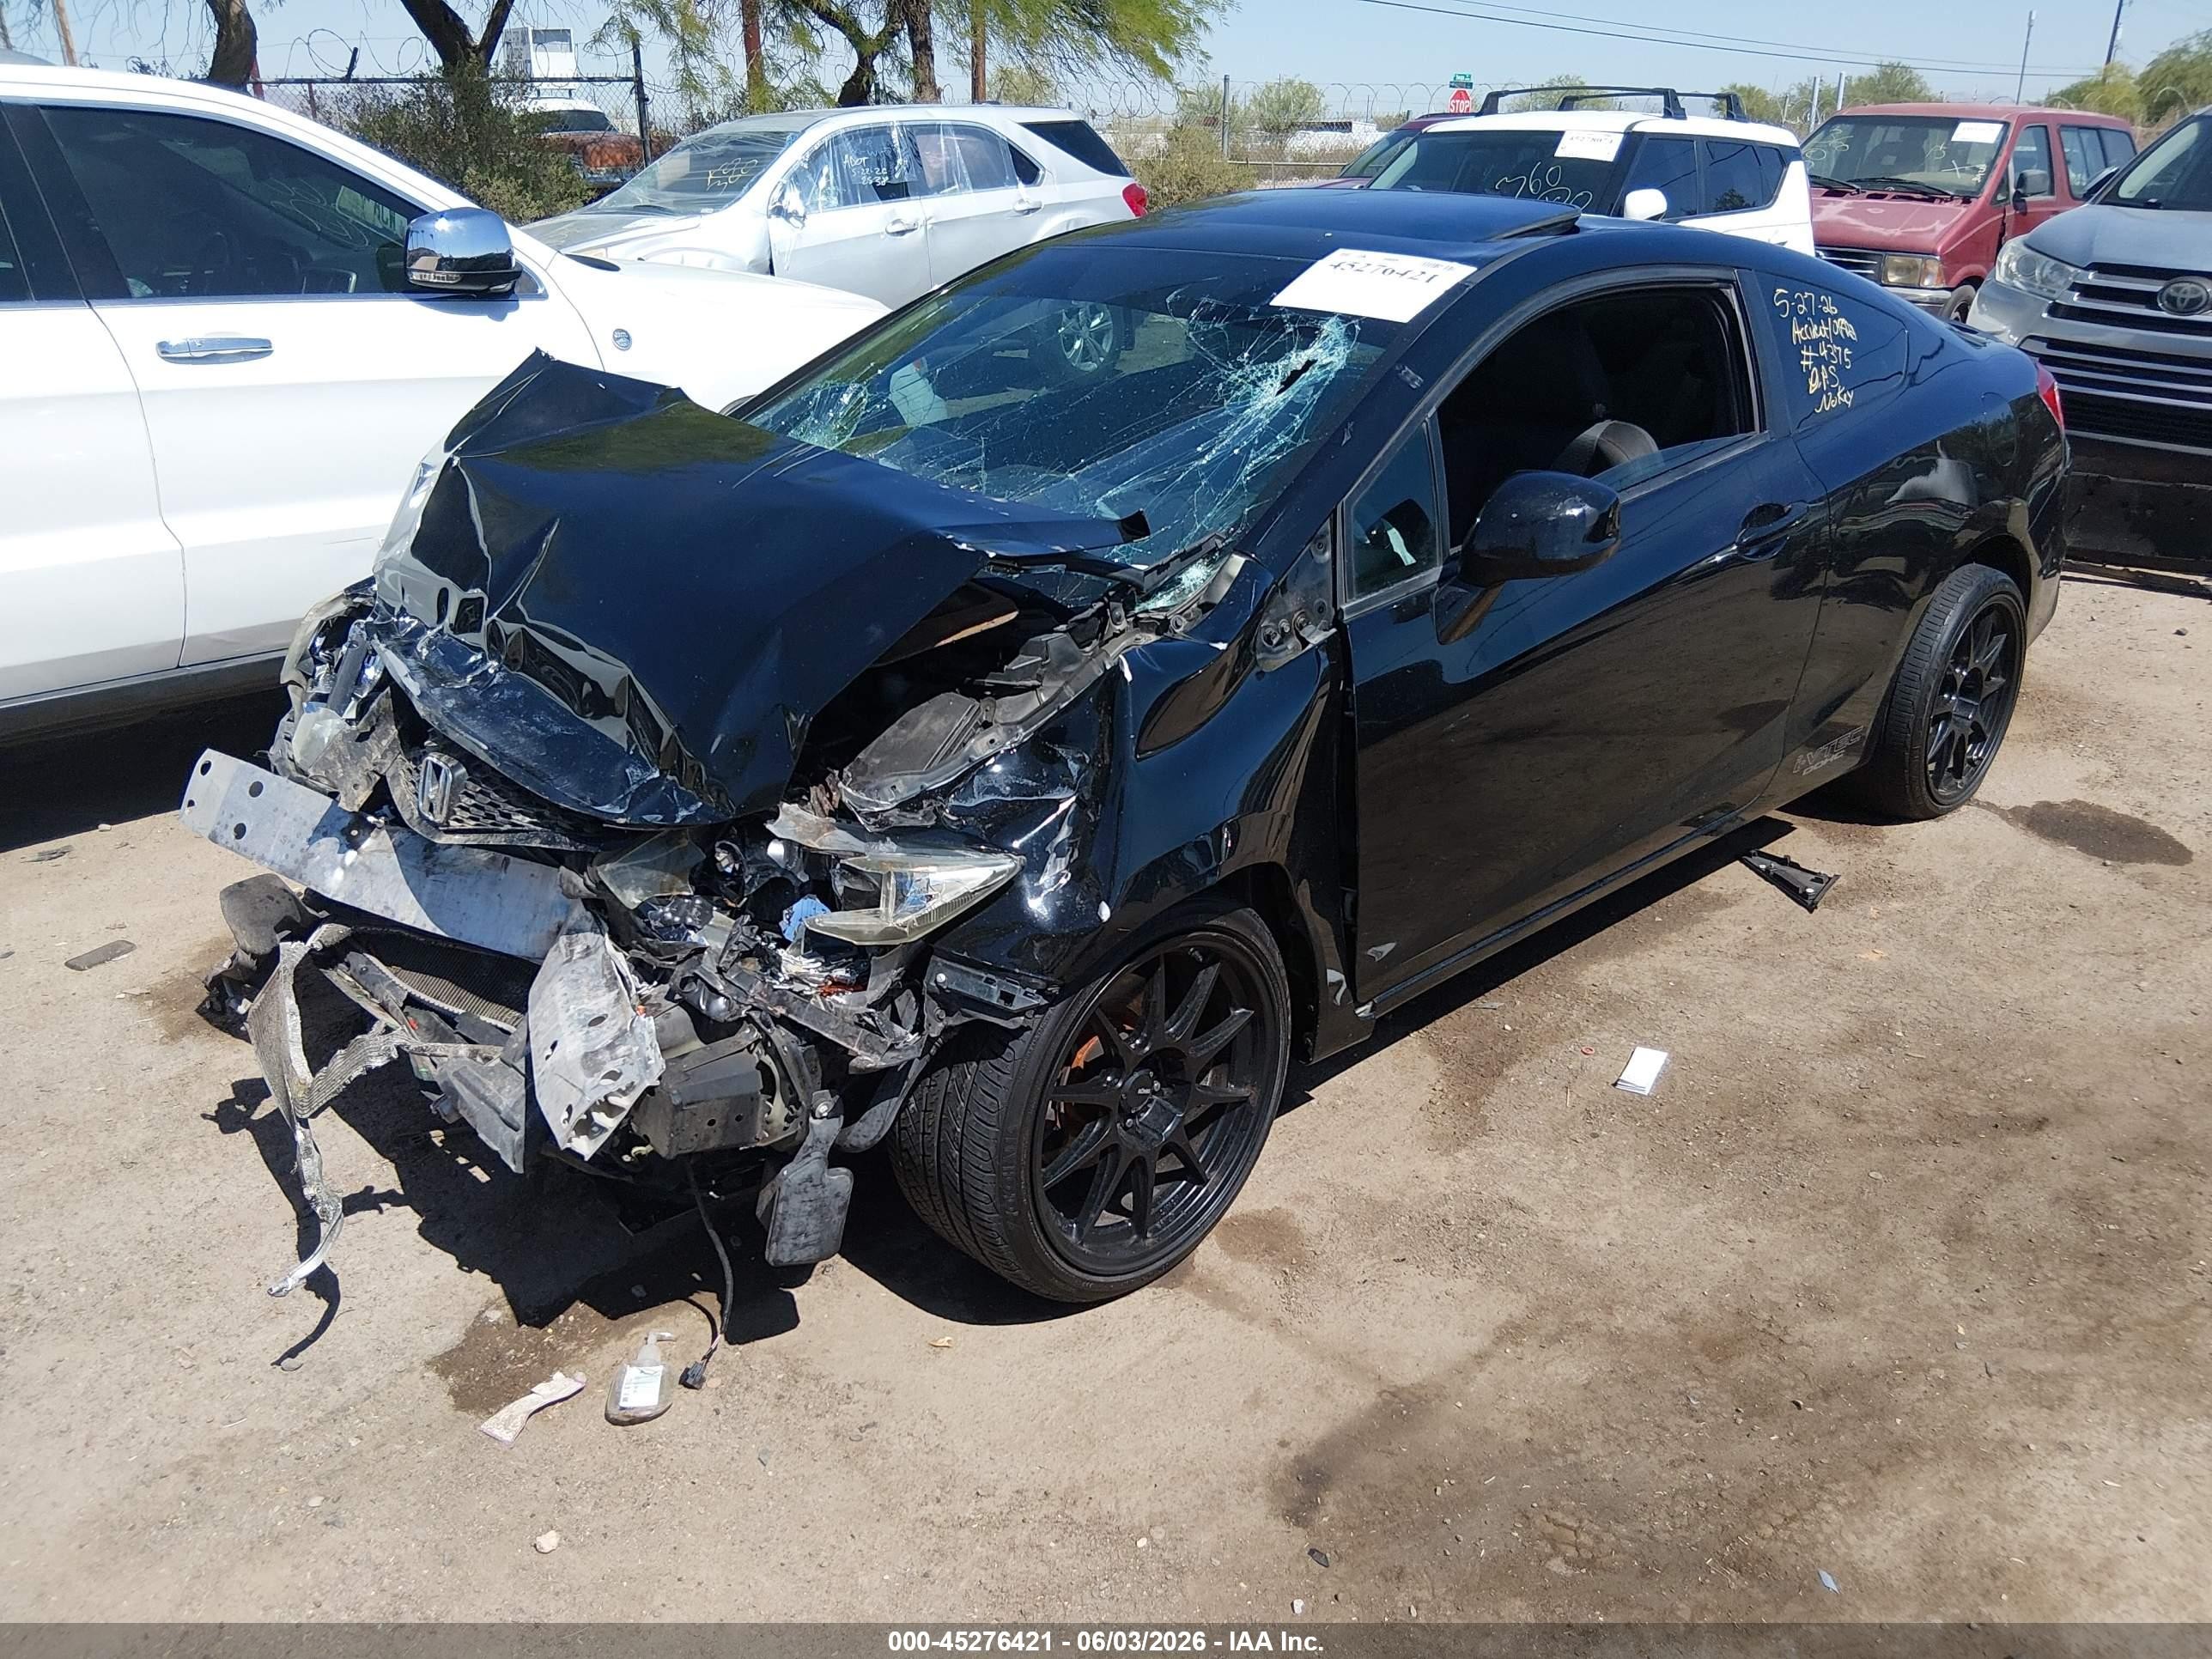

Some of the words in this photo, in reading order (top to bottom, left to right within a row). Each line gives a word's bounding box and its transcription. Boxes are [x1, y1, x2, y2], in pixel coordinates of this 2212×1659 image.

[1449, 100, 1470, 113] STOP
[1773, 289, 1838, 318] 5-27-26
[1800, 341, 1853, 373] #4375
[1802, 750, 1845, 776] DOHC
